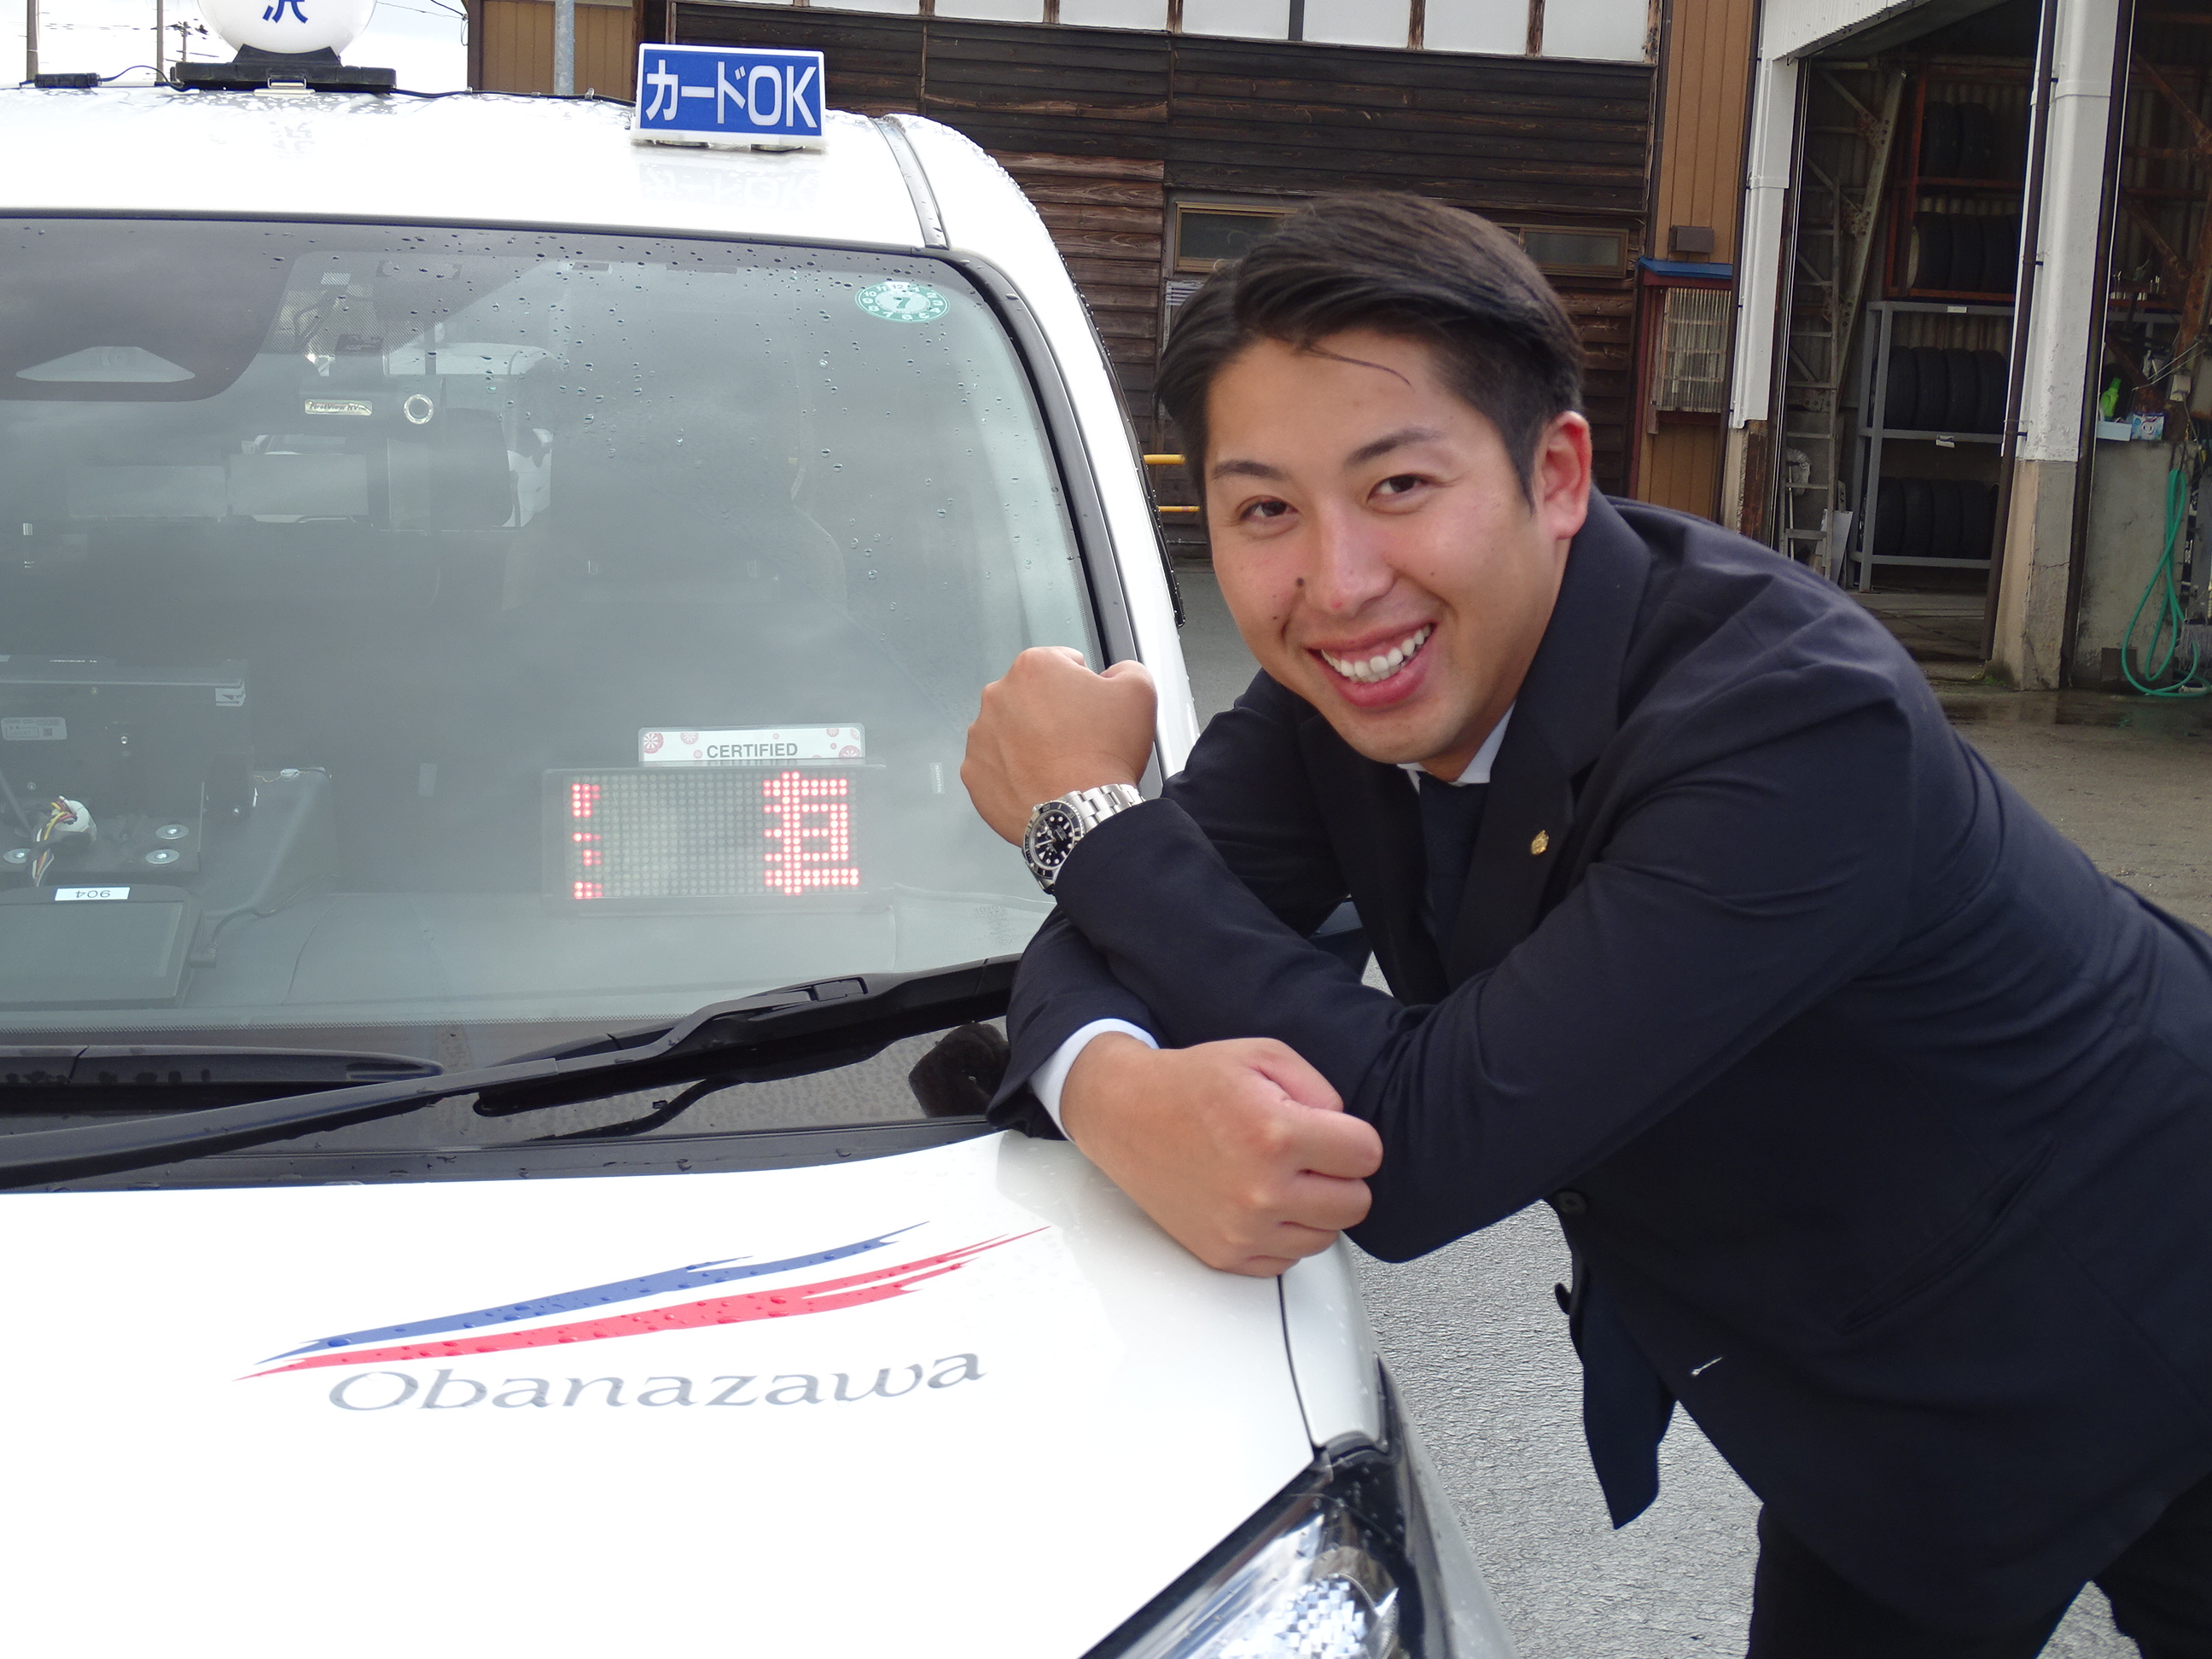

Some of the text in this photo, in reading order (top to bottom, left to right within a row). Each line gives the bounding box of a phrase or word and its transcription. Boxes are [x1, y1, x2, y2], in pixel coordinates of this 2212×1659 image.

[645, 59, 818, 128] カードOK
[893, 296, 911, 309] 7
[707, 742, 798, 759] CERTIFIED
[75, 890, 111, 899] 904
[329, 1352, 988, 1411] Obanazawa
